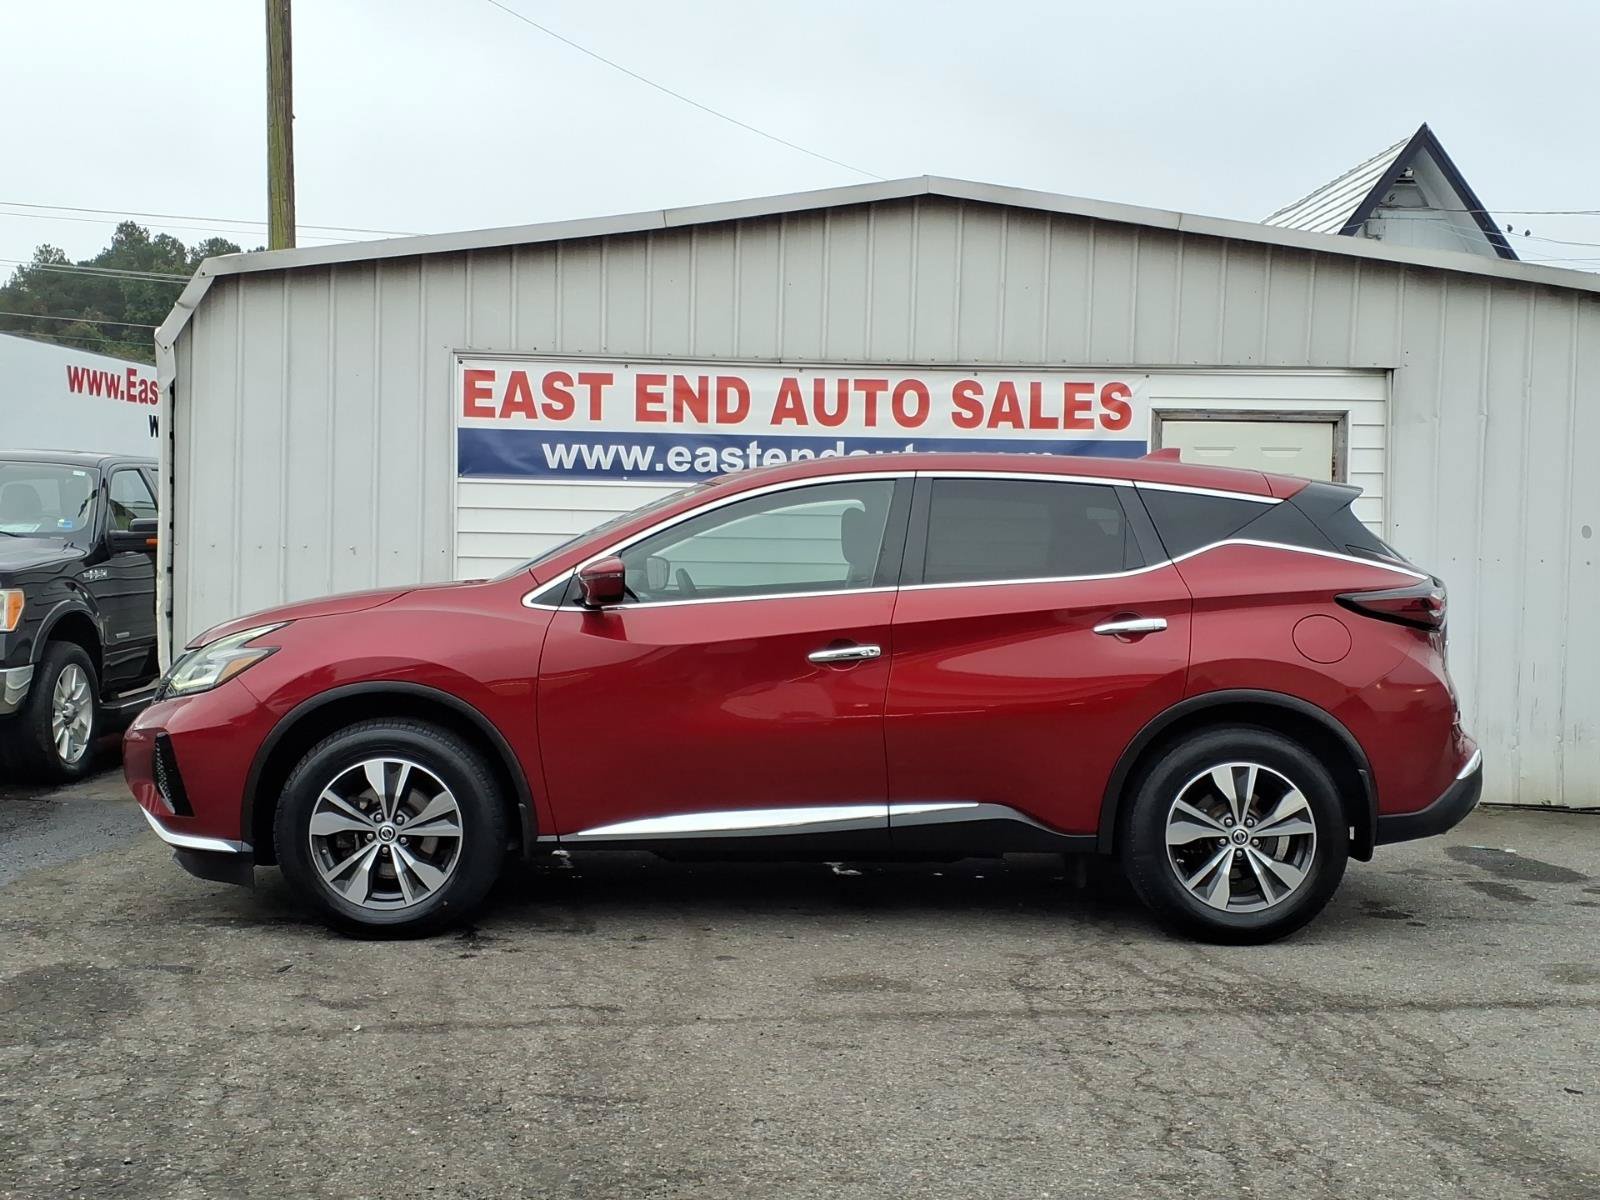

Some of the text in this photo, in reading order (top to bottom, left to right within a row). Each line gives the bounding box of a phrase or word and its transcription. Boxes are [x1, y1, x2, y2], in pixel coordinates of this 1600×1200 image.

[463, 369, 1133, 431] EAST END AUTO SALES
[541, 440, 1053, 474] www.eastend
